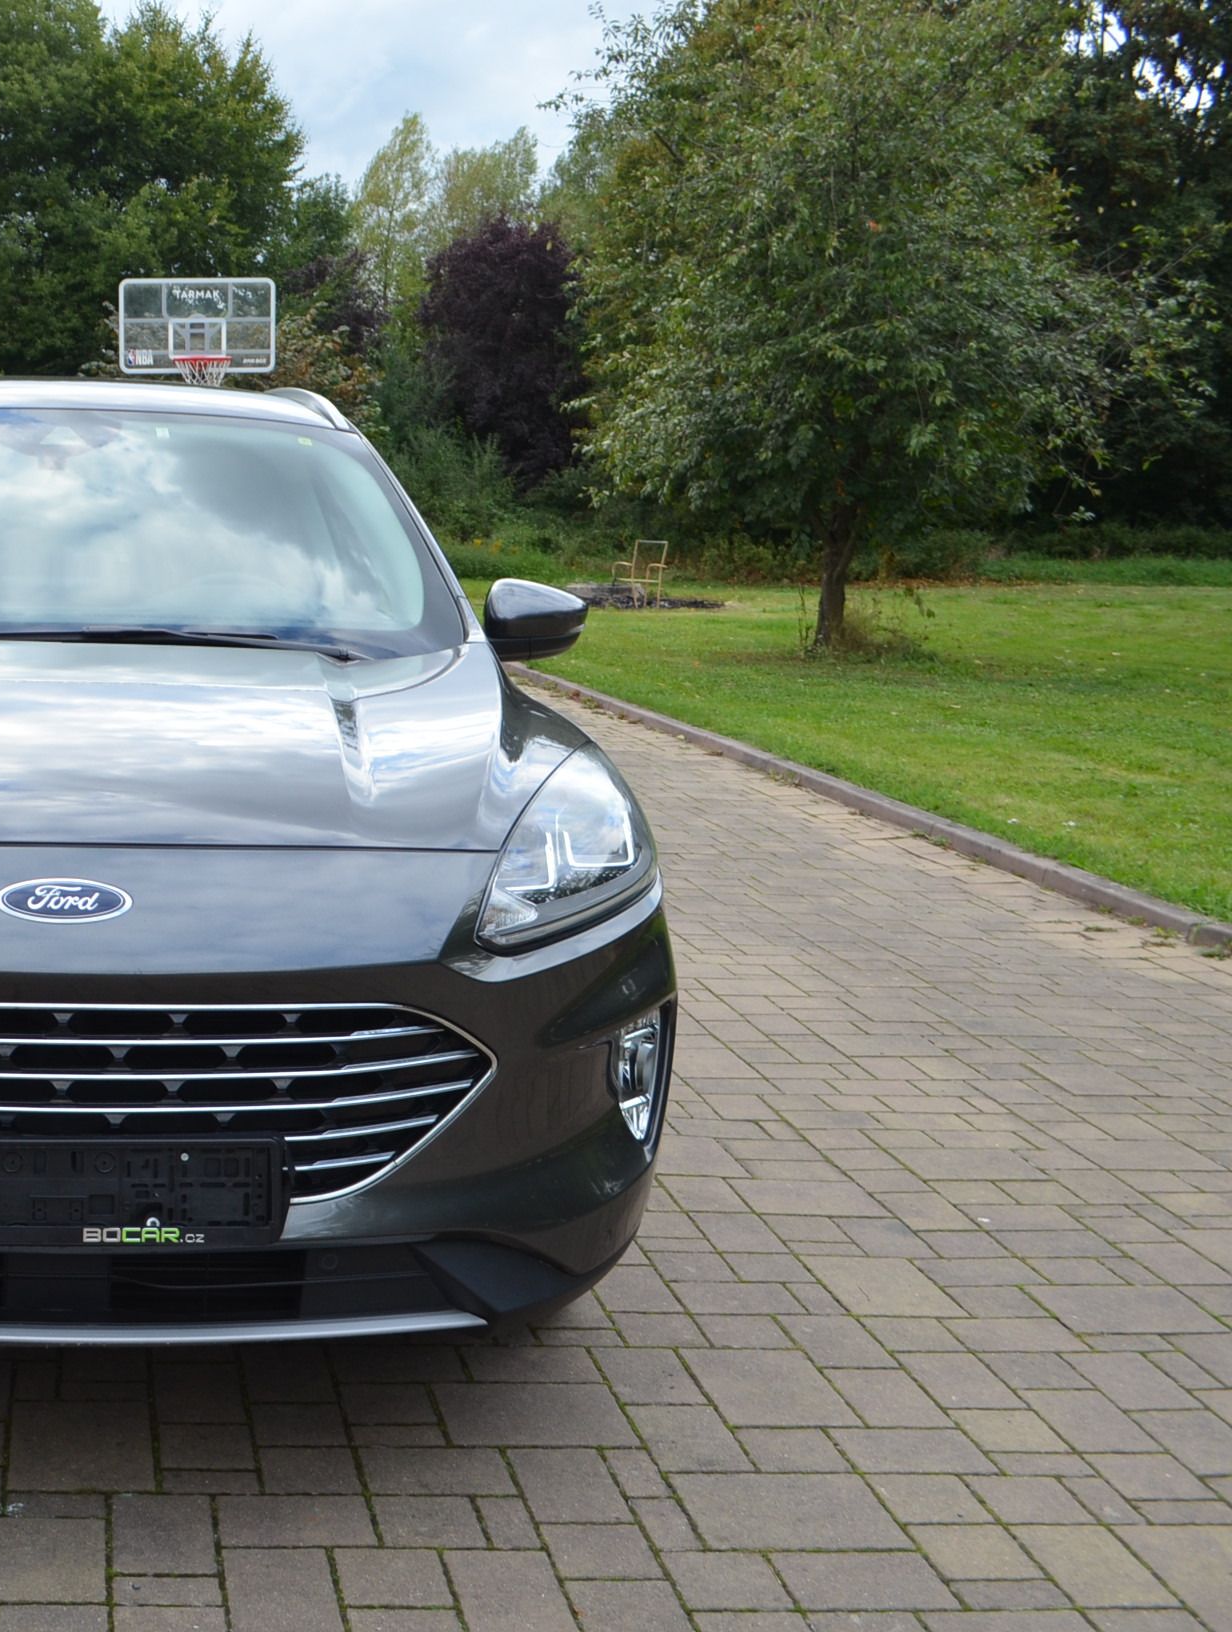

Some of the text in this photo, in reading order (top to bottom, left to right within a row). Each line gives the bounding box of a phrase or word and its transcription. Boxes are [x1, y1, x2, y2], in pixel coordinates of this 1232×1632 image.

[175, 289, 220, 300] TARMAK
[135, 349, 154, 365] NBA
[27, 885, 100, 910] Ford
